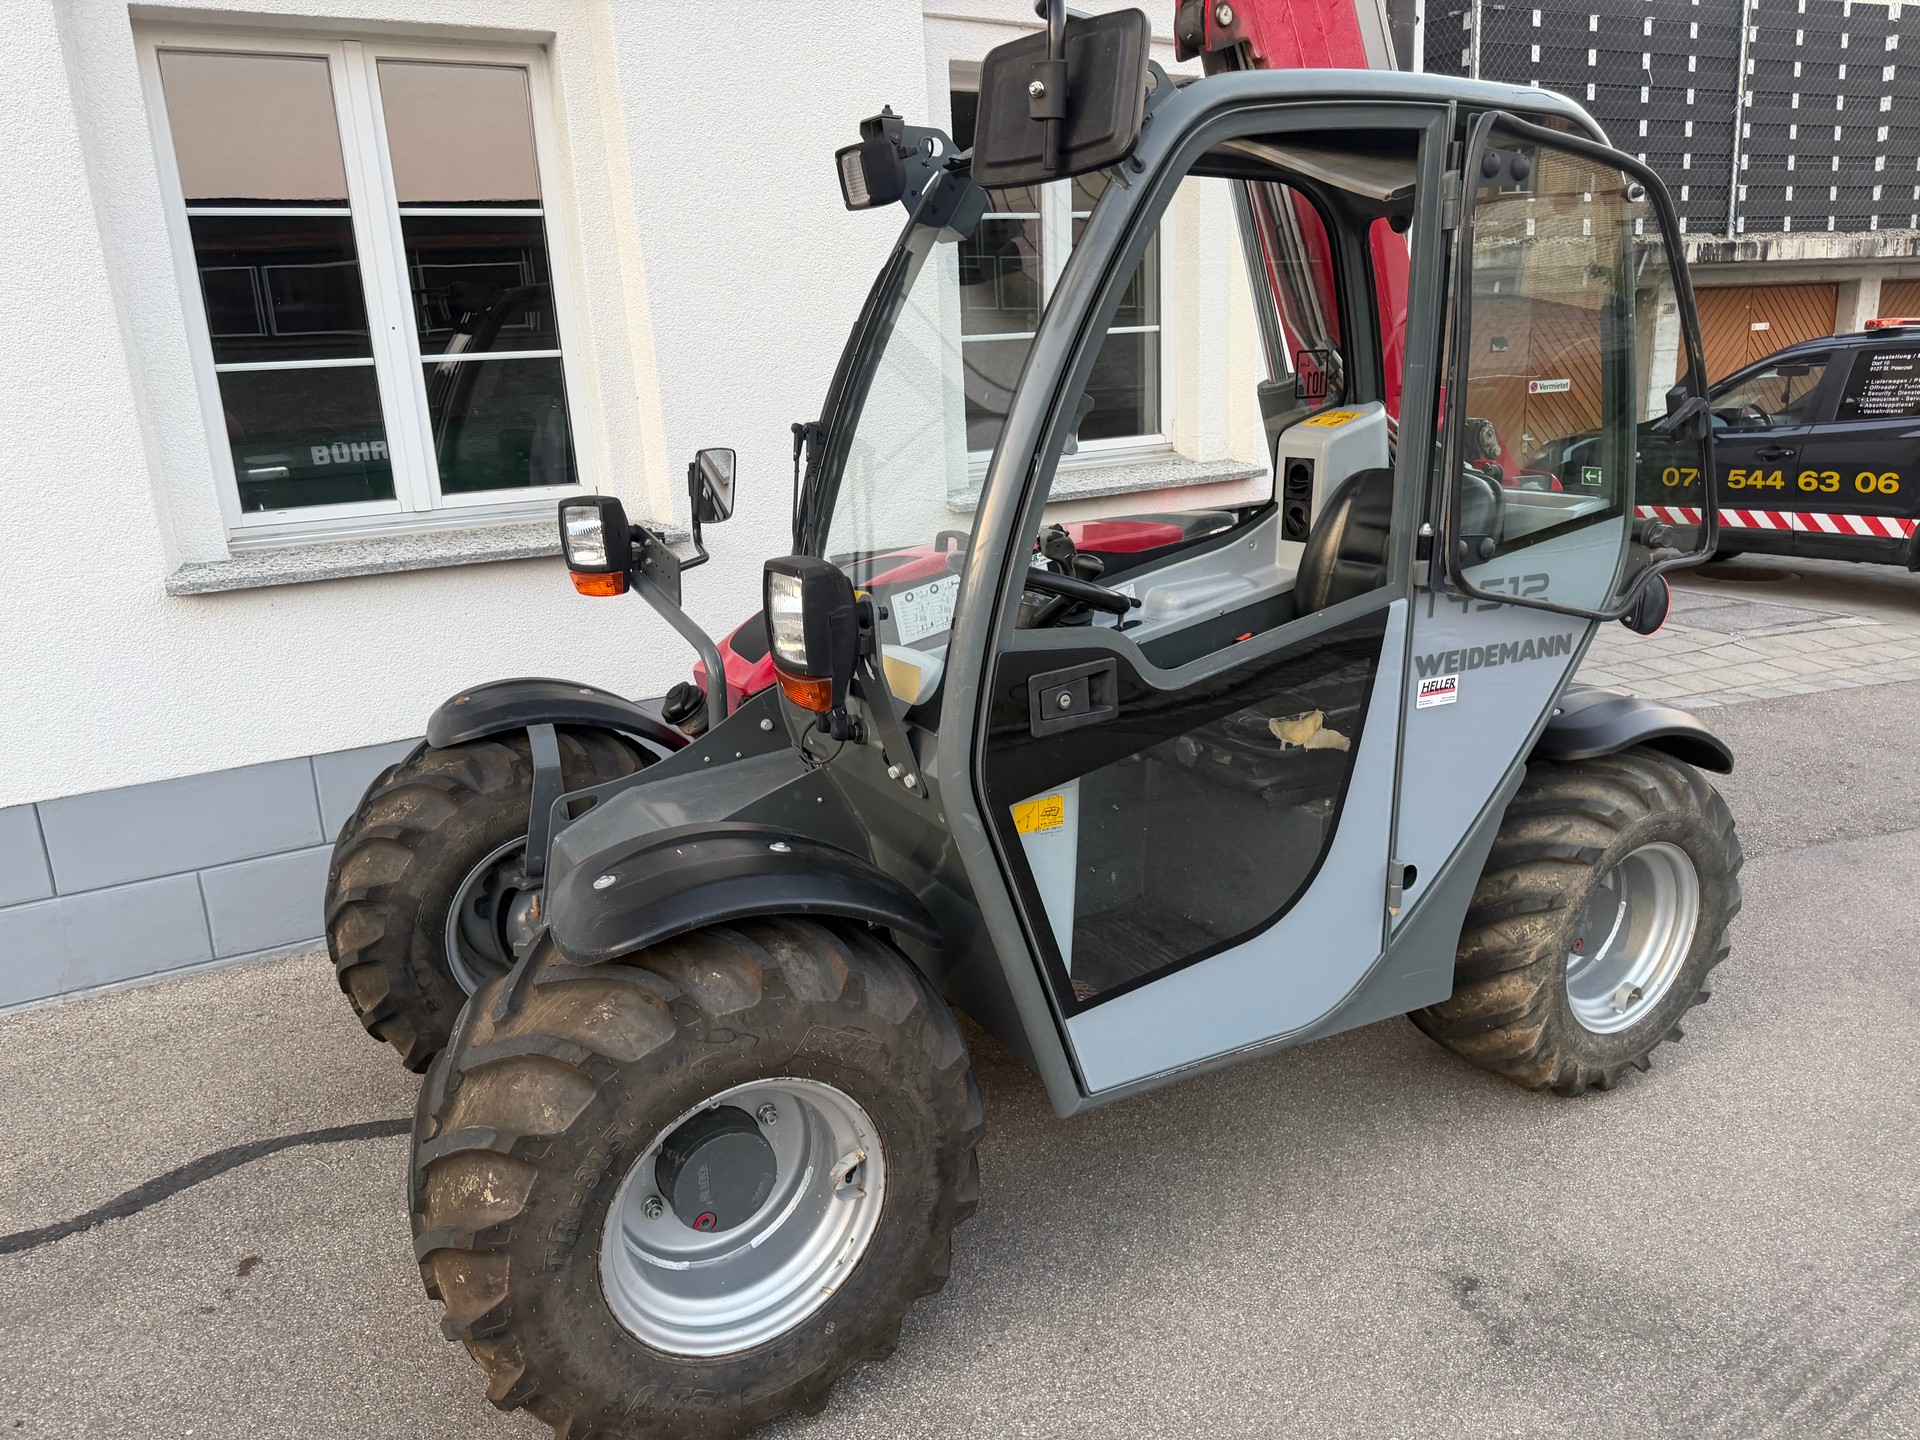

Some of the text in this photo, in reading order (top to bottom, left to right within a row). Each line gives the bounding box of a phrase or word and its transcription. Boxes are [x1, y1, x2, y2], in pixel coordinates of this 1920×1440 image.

[1539, 382, 1569, 390] Vermietet
[1662, 468, 1900, 494] 07 544 63 06
[1415, 633, 1573, 677] WEIDEMANN
[1419, 678, 1456, 694] HELLER
